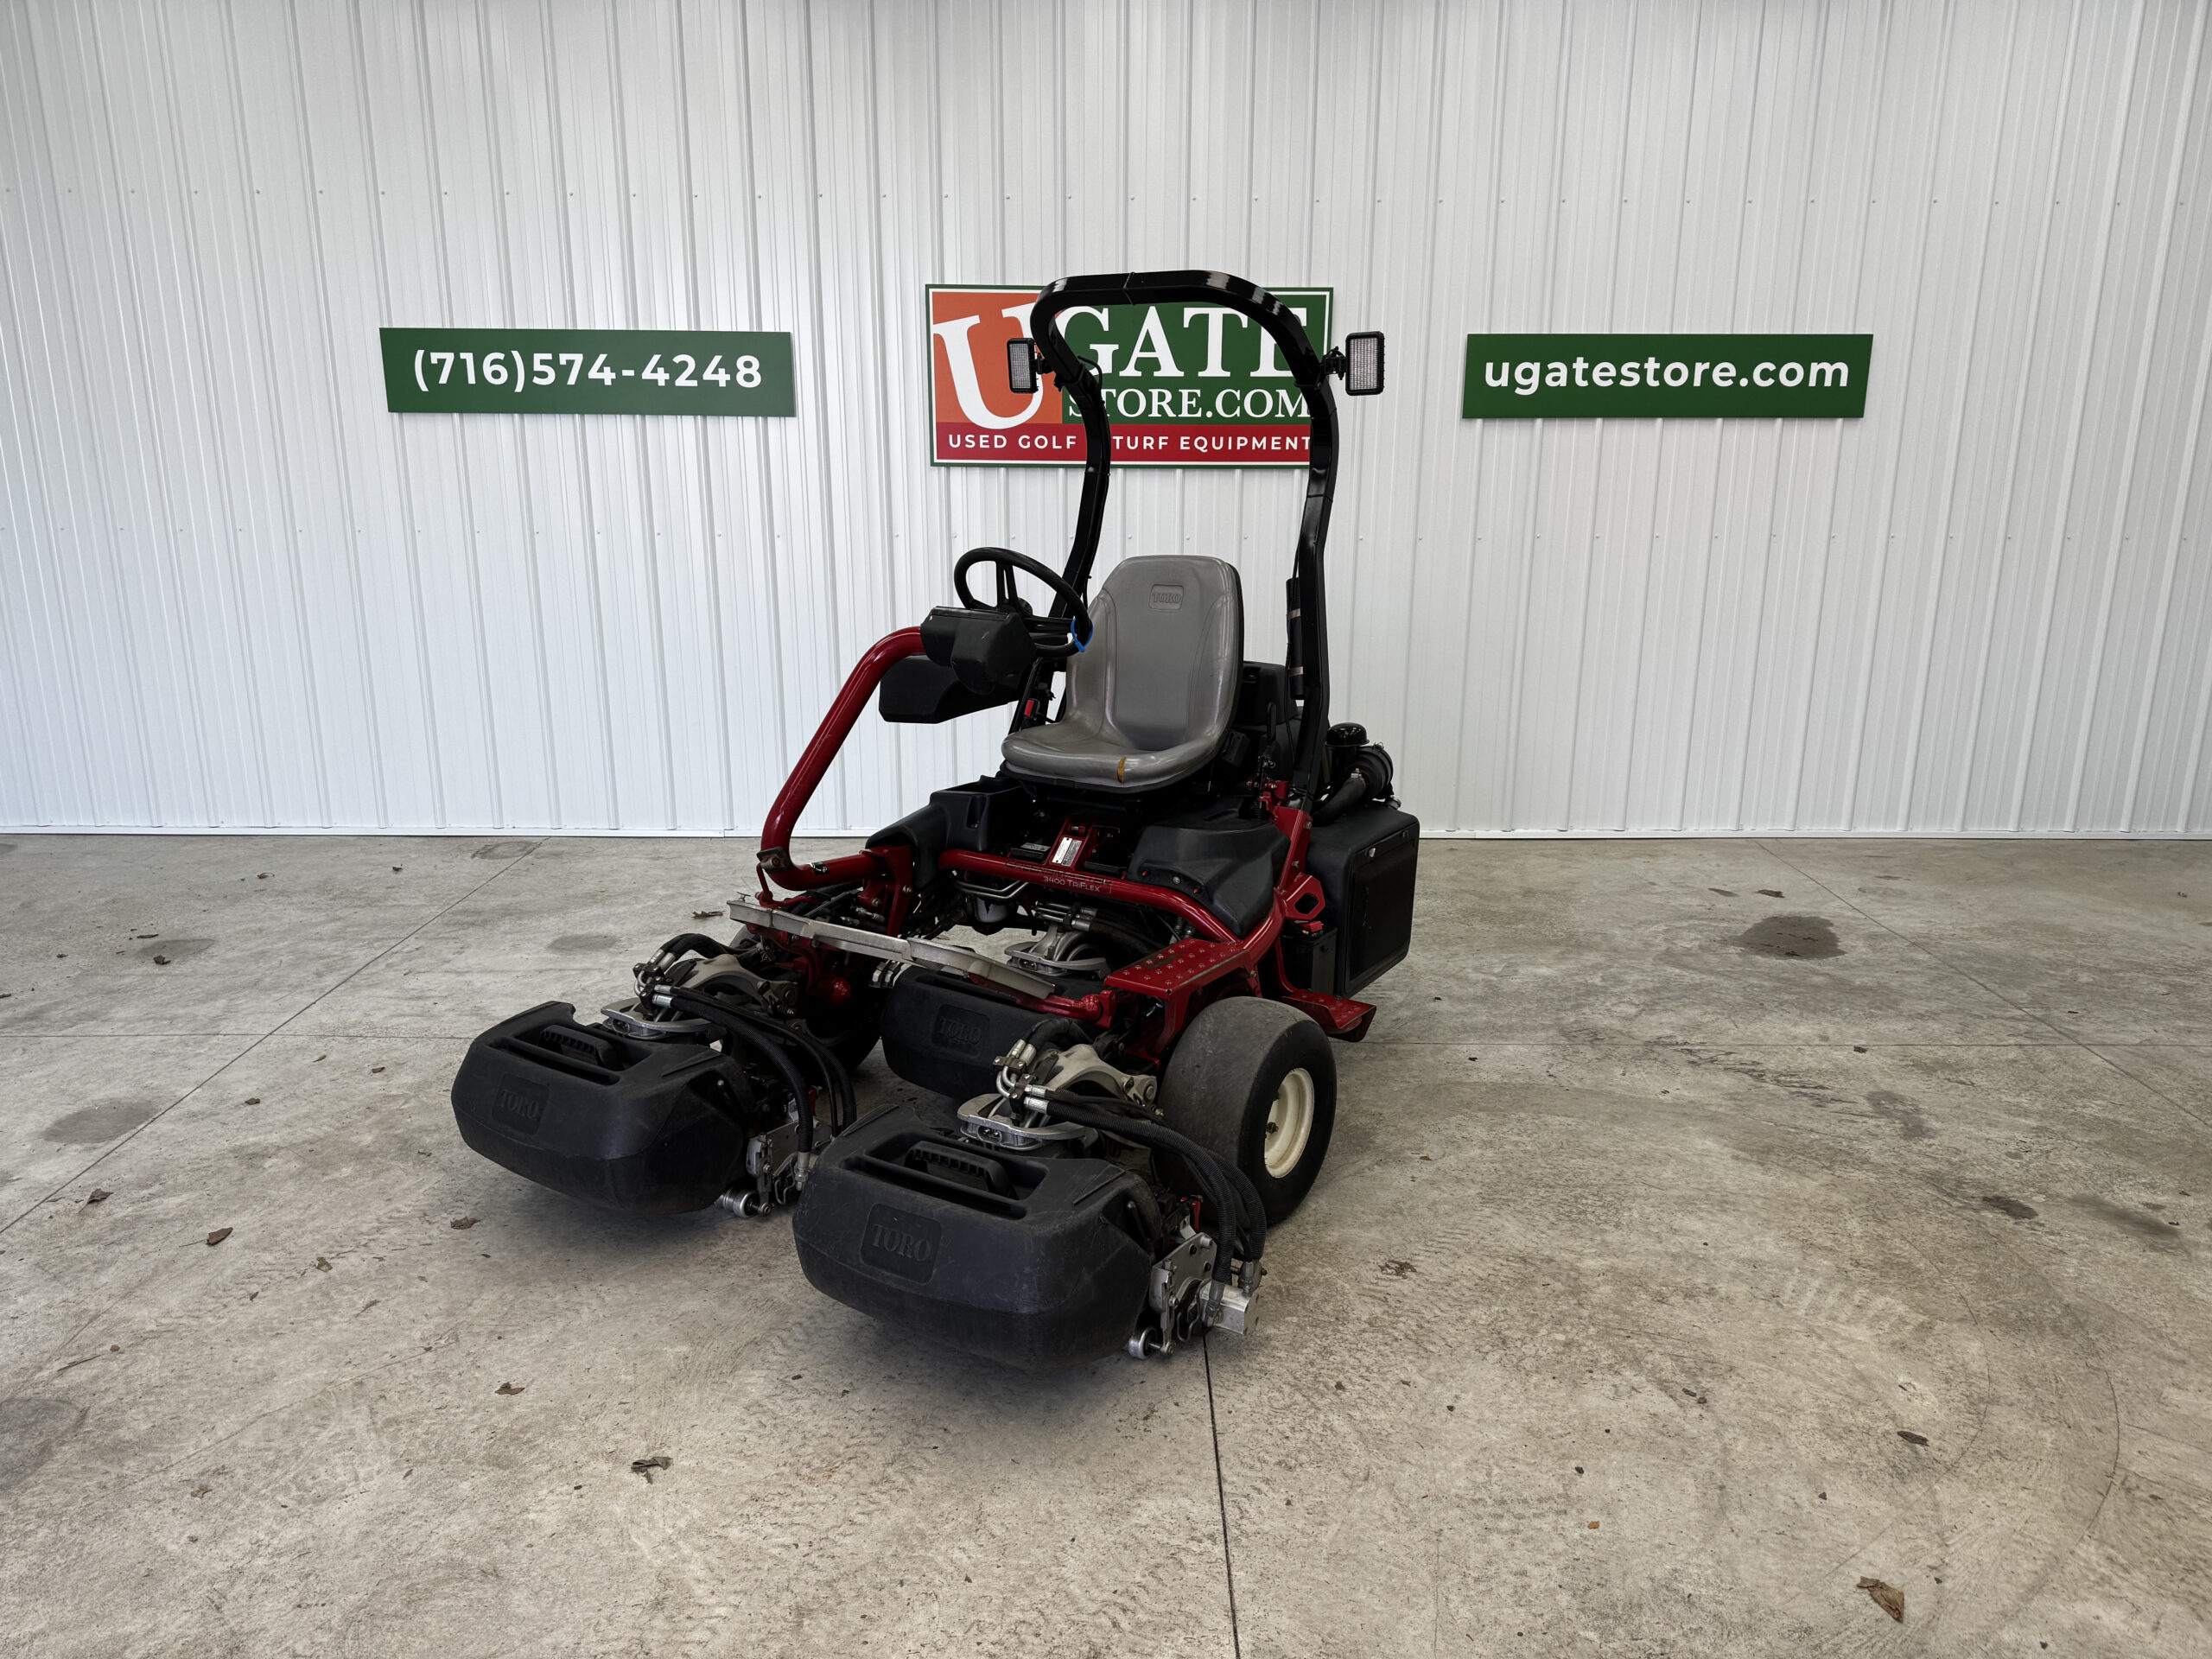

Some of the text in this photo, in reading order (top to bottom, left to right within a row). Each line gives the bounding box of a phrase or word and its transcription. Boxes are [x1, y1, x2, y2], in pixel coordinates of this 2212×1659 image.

[414, 349, 762, 393] (716)574-4248
[1484, 356, 1850, 396] ugatestore.com
[949, 434, 1311, 453] USED GOLF TURF EQUIPMENT
[1152, 592, 1182, 604] TORO
[1043, 875, 1065, 887] 3400
[938, 1017, 982, 1045] TORO
[500, 1089, 539, 1120] TORO
[872, 1223, 932, 1262] TORO
